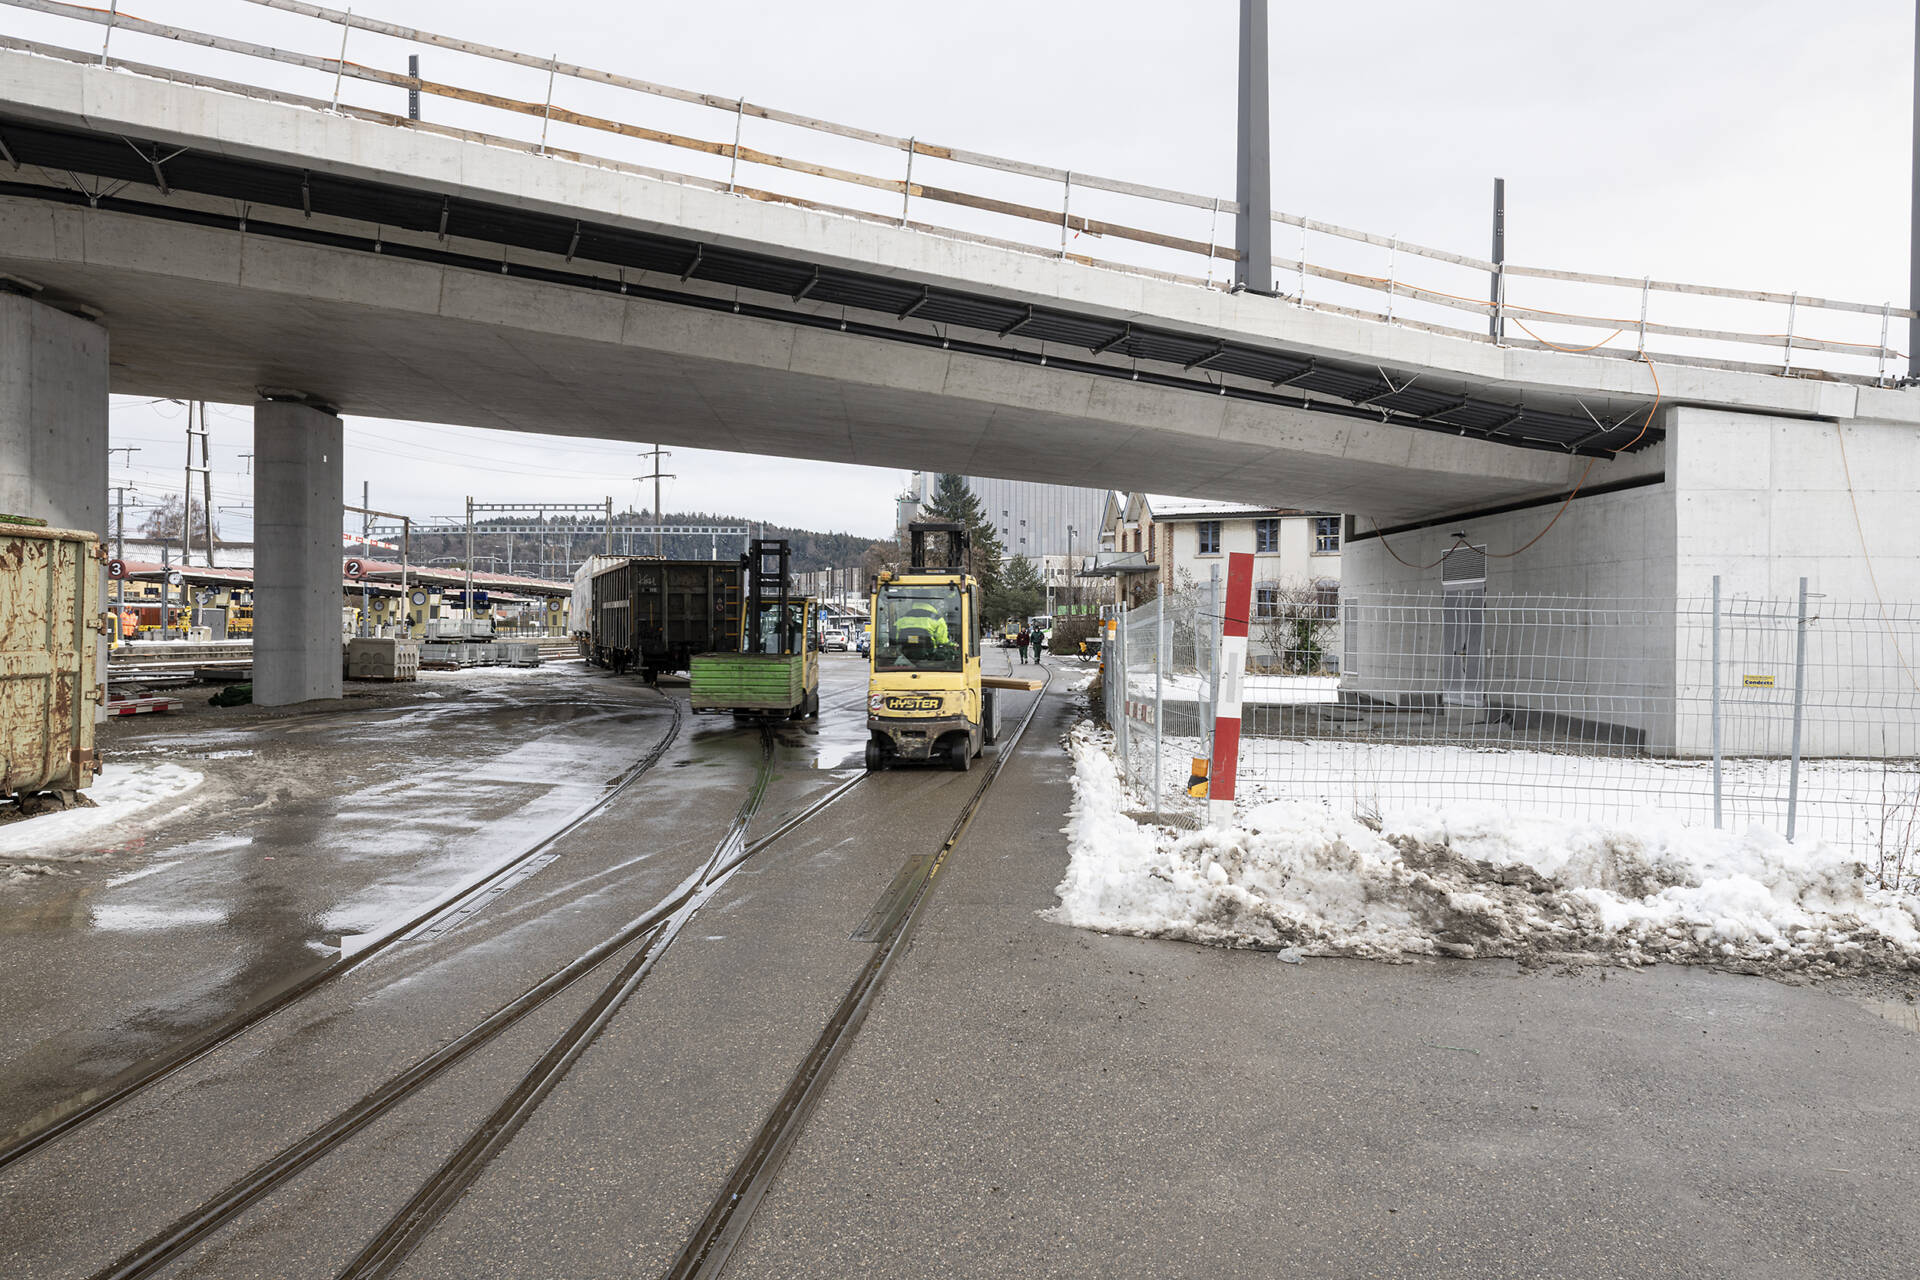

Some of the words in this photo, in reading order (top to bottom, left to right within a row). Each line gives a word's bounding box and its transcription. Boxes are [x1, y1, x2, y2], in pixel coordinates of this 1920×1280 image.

[111, 562, 121, 575] 3
[349, 562, 359, 575] 2
[889, 699, 939, 709] HYSTER
